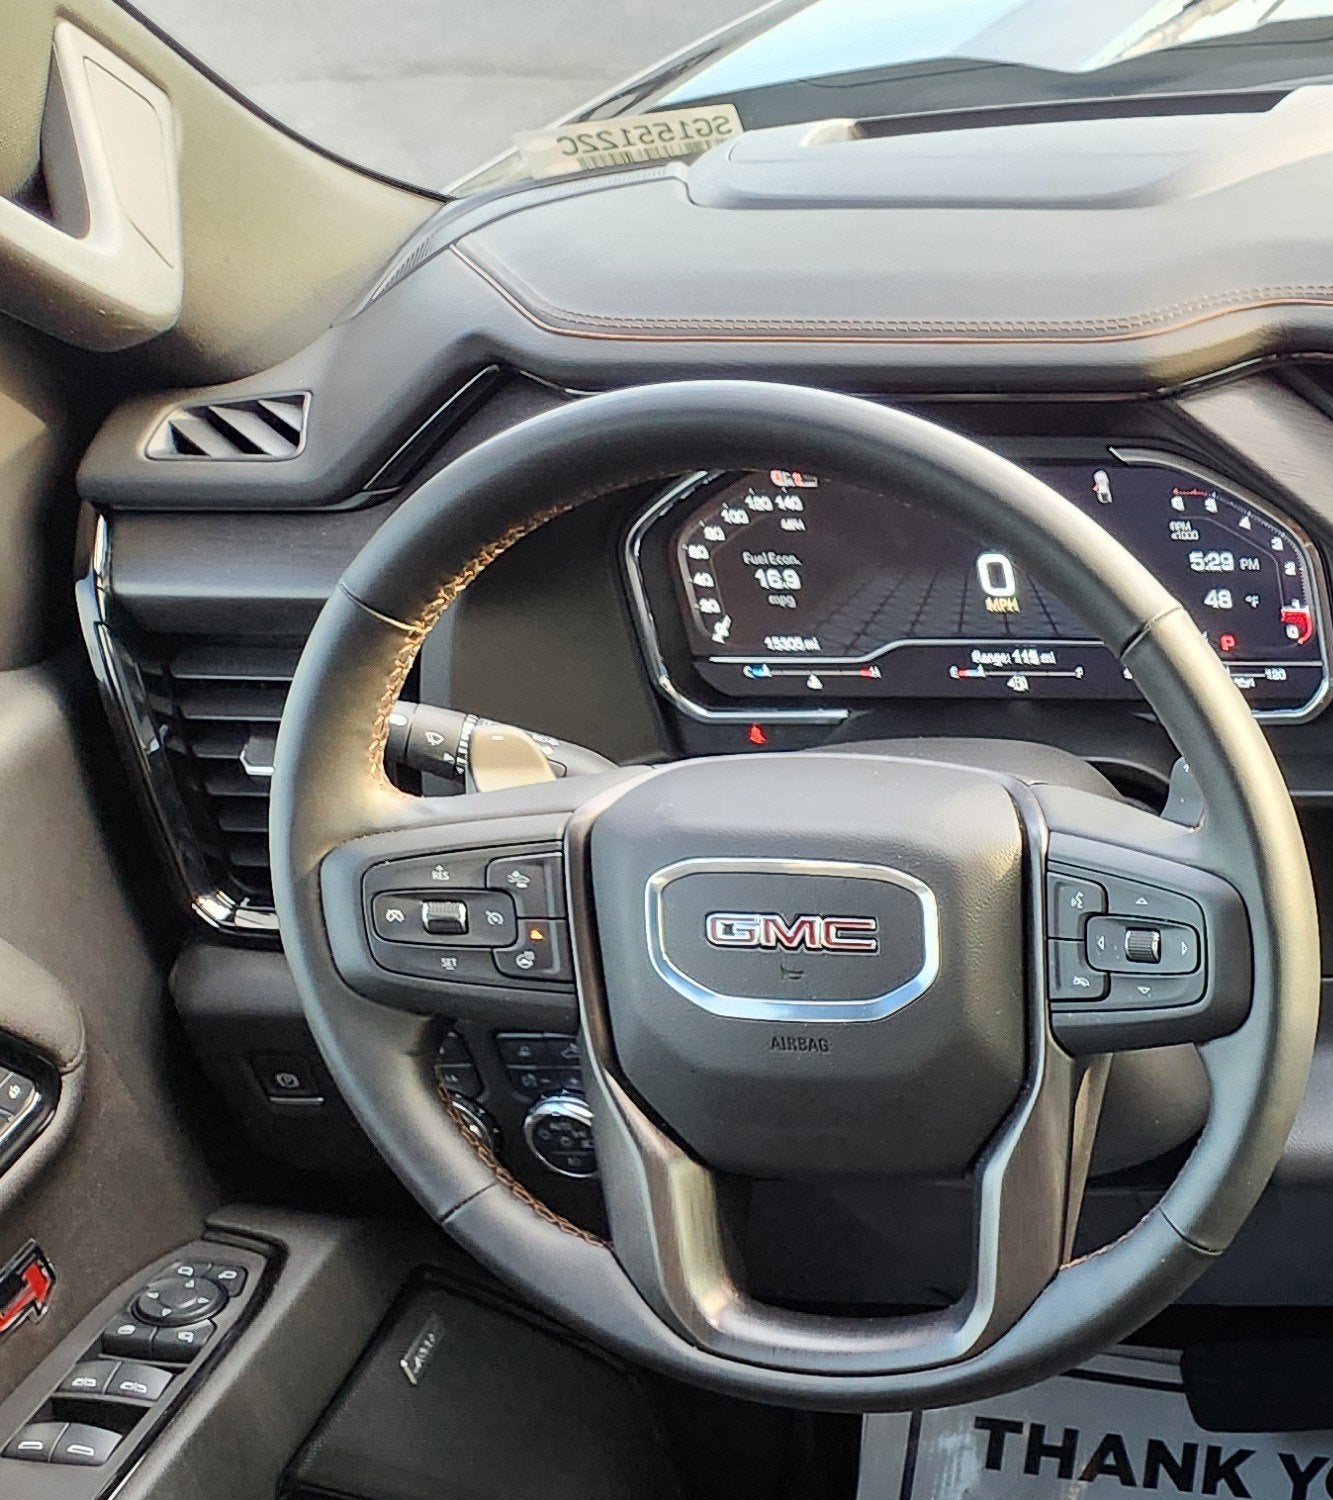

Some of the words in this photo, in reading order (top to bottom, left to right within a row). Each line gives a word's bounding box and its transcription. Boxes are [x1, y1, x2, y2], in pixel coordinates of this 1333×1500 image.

[742, 551, 768, 565] Fuel
[1239, 557, 1260, 571] PM
[977, 553, 1016, 597] 0
[985, 596, 1021, 613] MPH
[1204, 588, 1233, 609] 48
[1220, 634, 1236, 651] P
[705, 911, 878, 952] GMC
[771, 1036, 829, 1052] AIRBAG
[974, 1416, 1255, 1500] THANK
